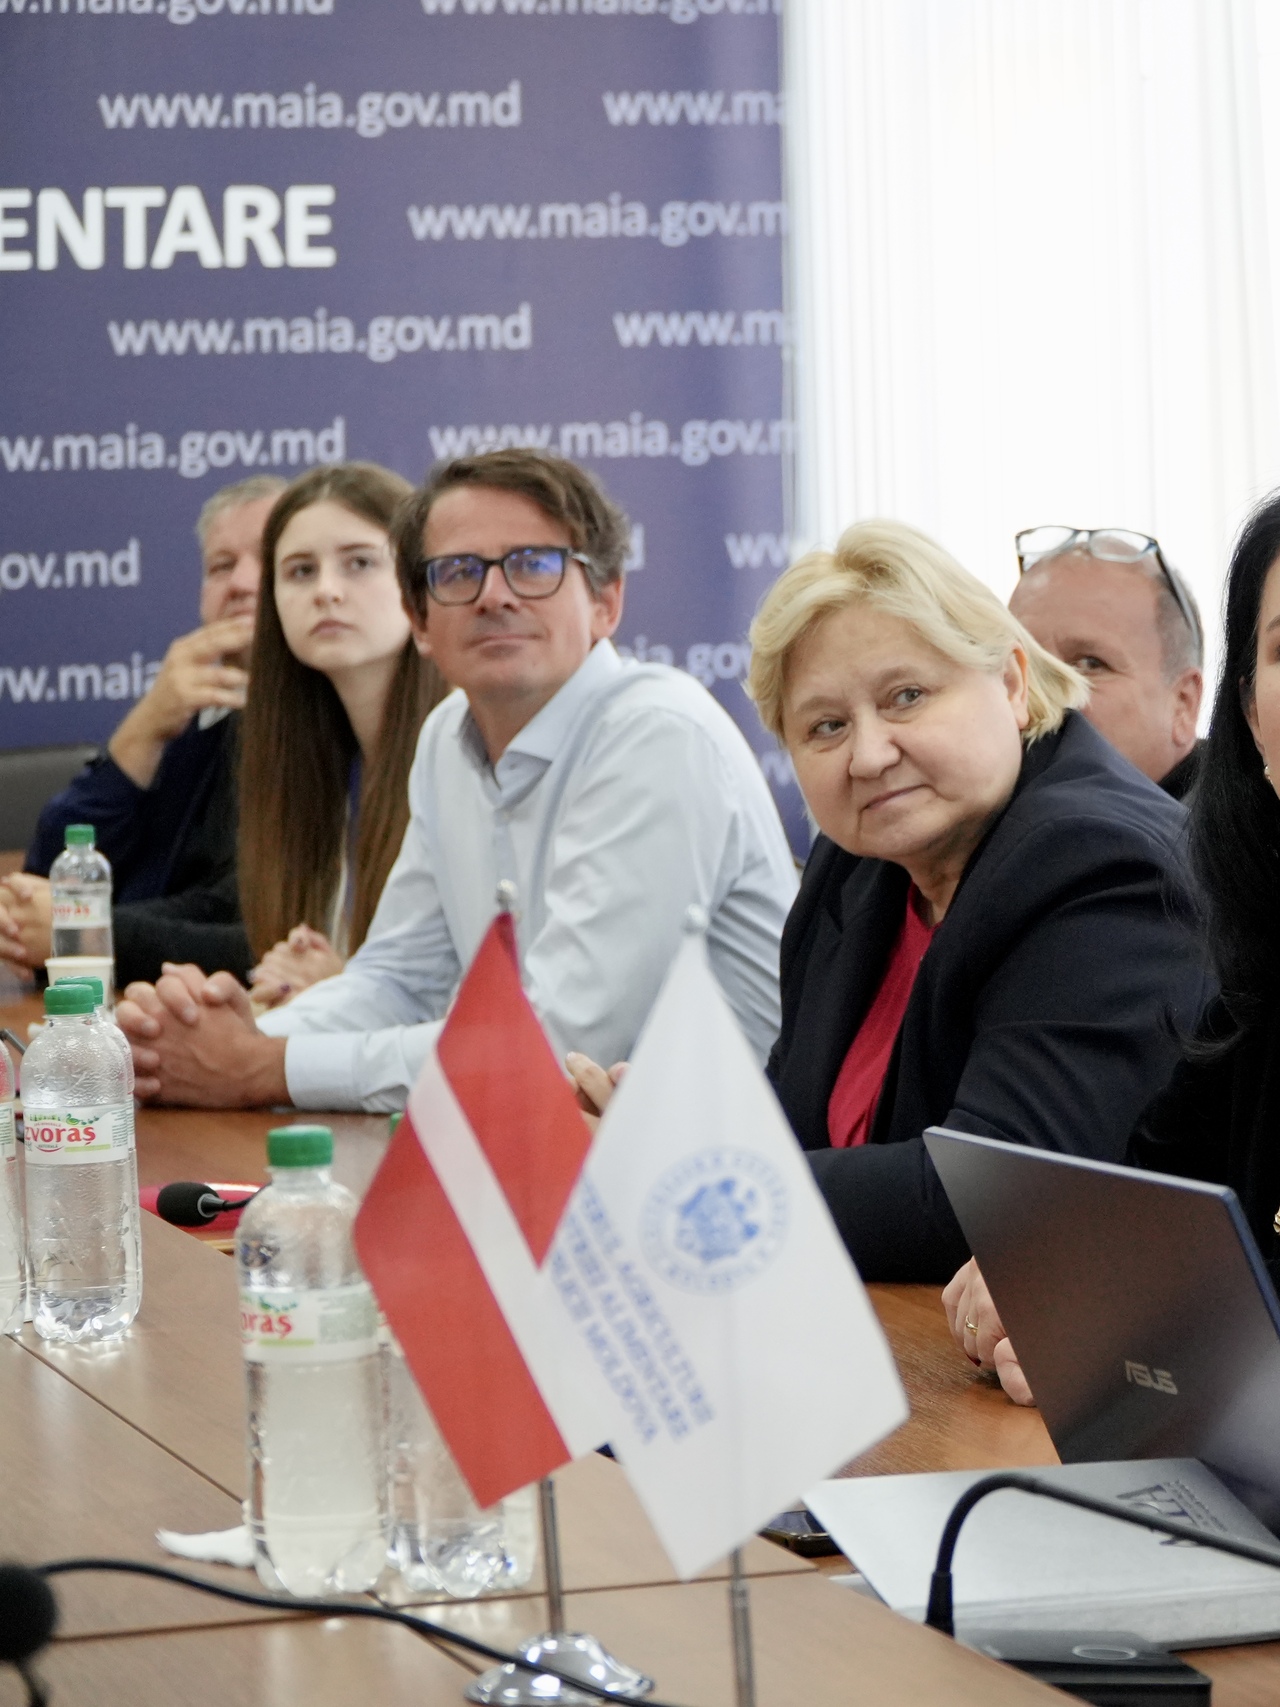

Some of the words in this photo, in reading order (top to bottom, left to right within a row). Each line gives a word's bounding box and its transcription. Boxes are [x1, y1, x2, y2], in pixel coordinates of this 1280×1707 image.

[98, 80, 521, 138] www.maia.gov.md
[603, 90, 785, 126] www.m
[0, 185, 336, 270] ENTARE
[108, 303, 532, 362] www.maia.gov.md
[1124, 1360, 1178, 1395] ASUS
